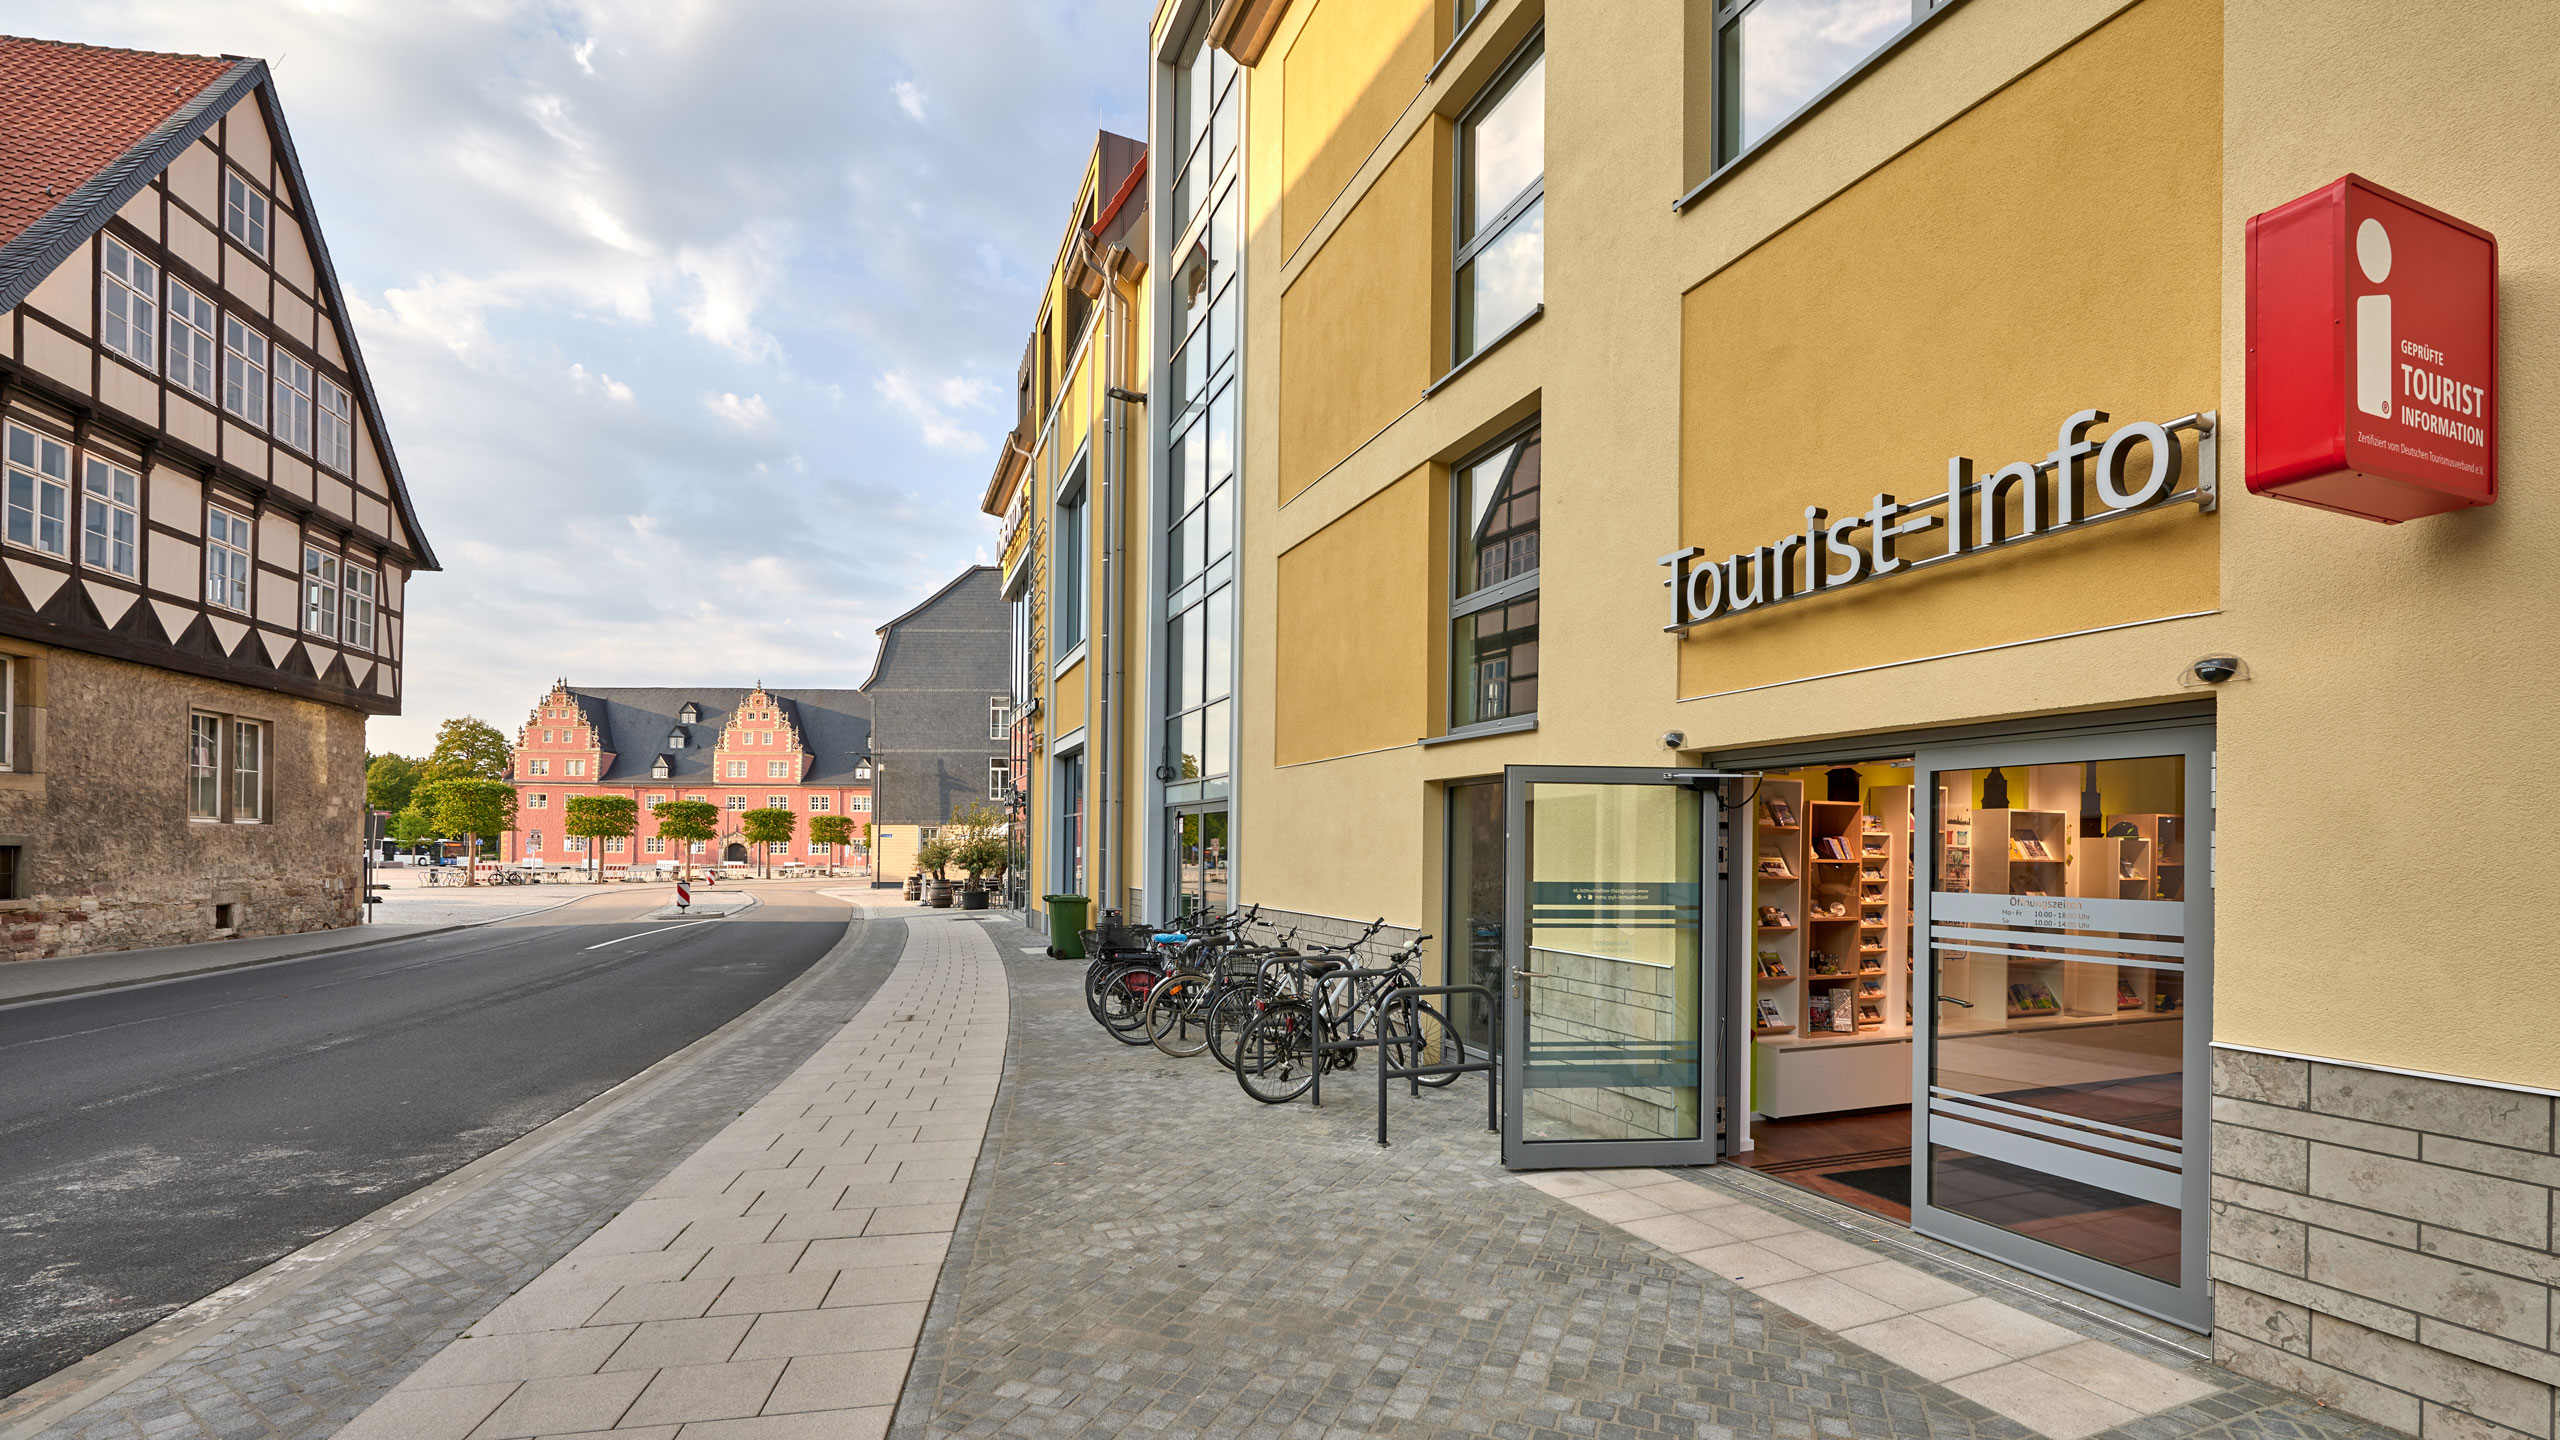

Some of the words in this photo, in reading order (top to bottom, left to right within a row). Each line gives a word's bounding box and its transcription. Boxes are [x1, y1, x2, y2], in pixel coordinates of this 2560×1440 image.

[2401, 339, 2444, 366] GEPRÜFTE
[2401, 363, 2484, 418] TOURIST
[2402, 405, 2484, 447] INFORMATION
[2357, 431, 2387, 449] Zertifiziert
[2388, 442, 2400, 452] vom
[2400, 443, 2429, 460] Deutschen
[2429, 451, 2475, 473] Tourismusverband
[2475, 465, 2485, 476] e.V.
[1657, 409, 2181, 625] Tourist-Info
[2009, 897, 2082, 910] Öffnungszeiten
[2034, 919, 2052, 927] 10.00
[2078, 921, 2090, 929] Uhr
